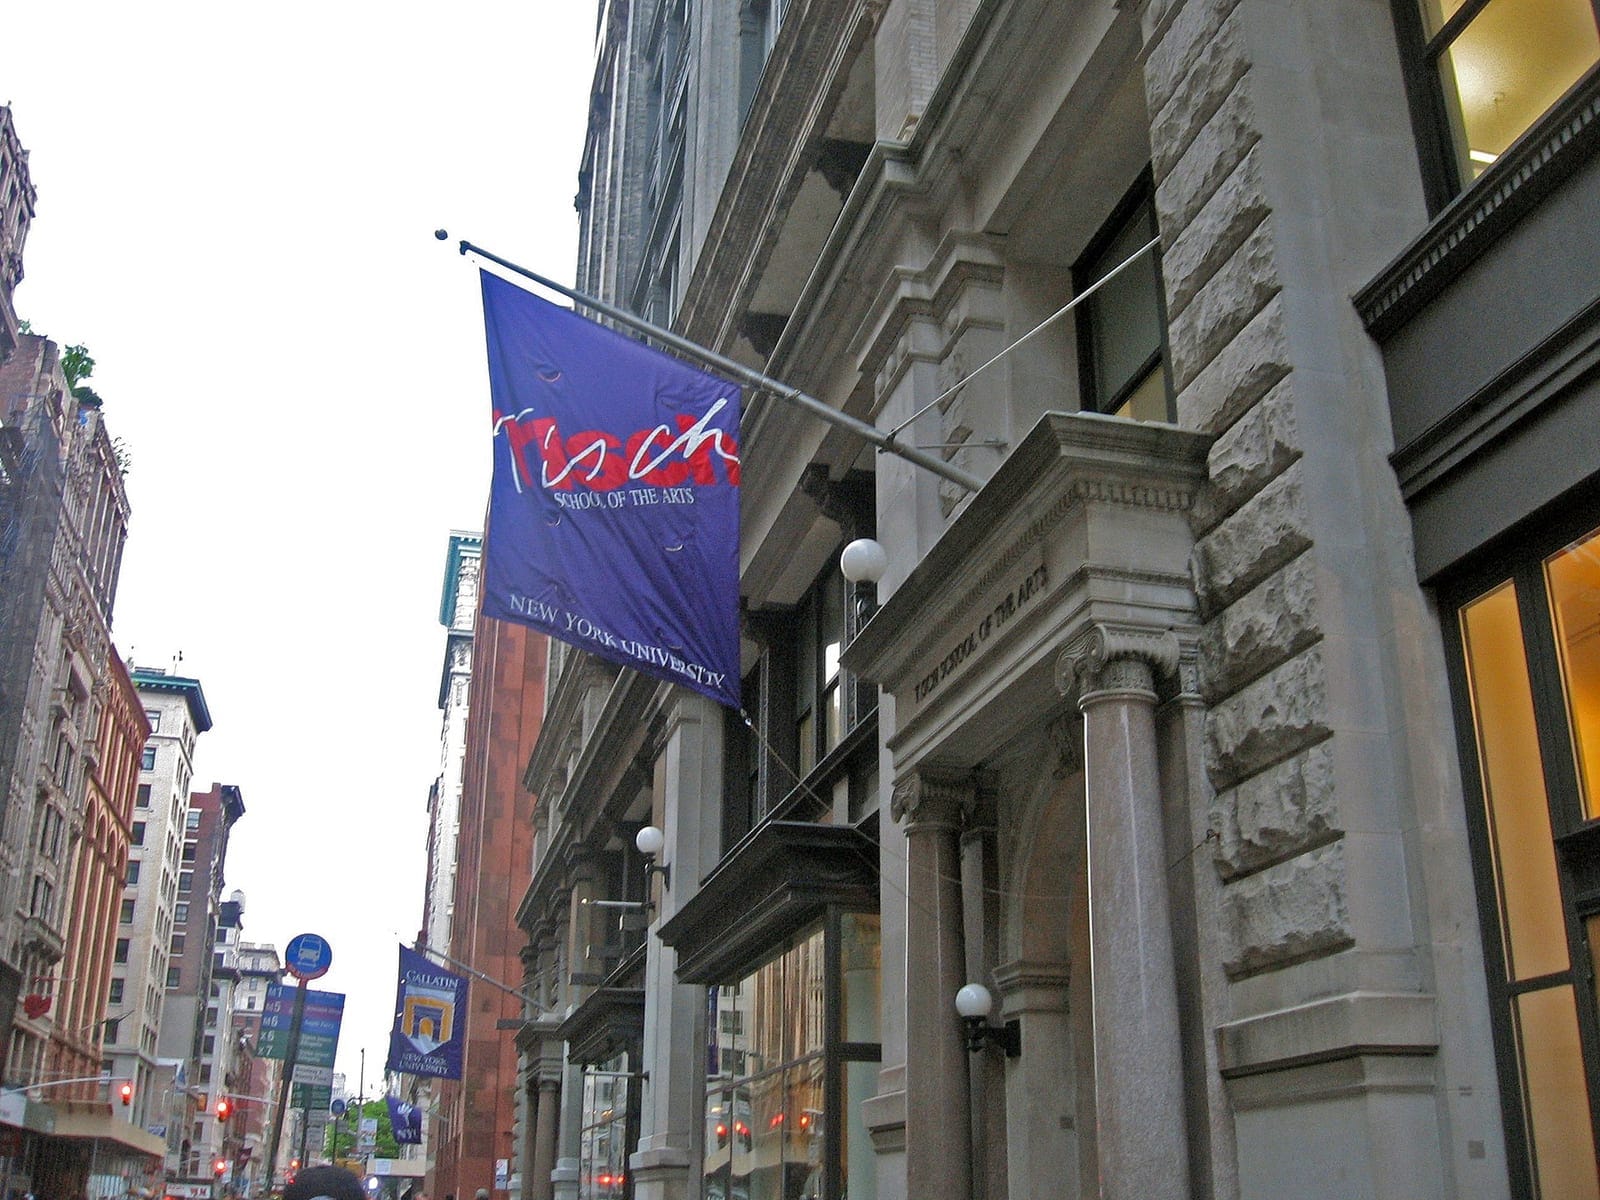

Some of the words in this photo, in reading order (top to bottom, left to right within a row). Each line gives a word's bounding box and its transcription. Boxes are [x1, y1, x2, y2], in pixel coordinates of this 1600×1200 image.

[554, 491, 606, 510] SCHOOL
[607, 491, 626, 508] OF
[629, 488, 660, 506] THE
[662, 487, 695, 504] ARTS
[978, 614, 993, 642] OF
[510, 594, 559, 623] NEW
[565, 612, 617, 648] YORK
[620, 640, 726, 689] UNIVERSITY
[406, 970, 459, 988] GALLATIN
[268, 986, 283, 998] M1
[265, 1001, 280, 1013] M5
[262, 1015, 278, 1027] M6
